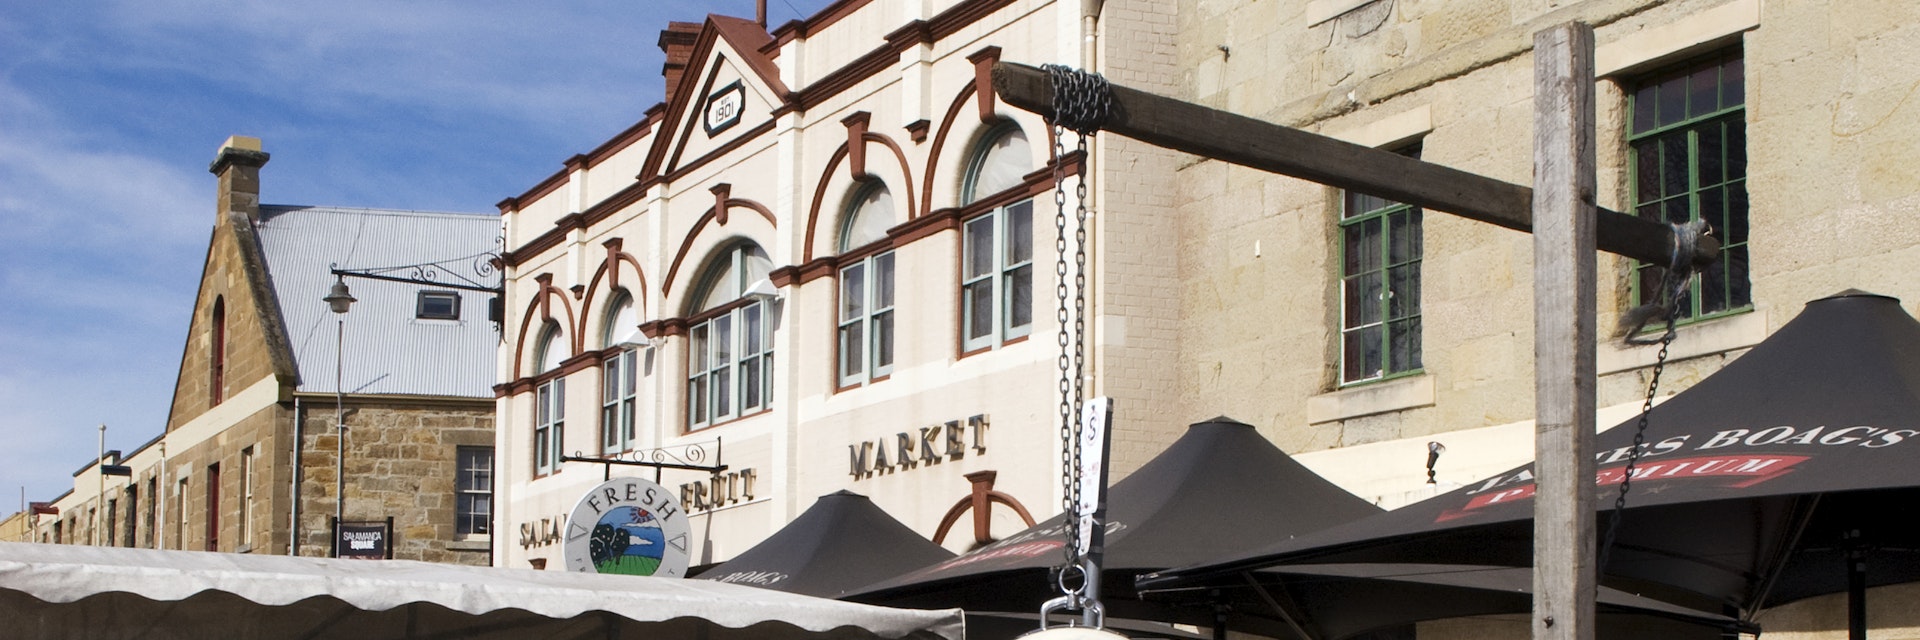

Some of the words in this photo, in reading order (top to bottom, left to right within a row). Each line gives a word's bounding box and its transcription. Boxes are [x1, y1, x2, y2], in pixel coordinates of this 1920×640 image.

[715, 101, 734, 123] 1901
[679, 468, 757, 514] FRUIT
[848, 413, 991, 482] MARKET
[1465, 434, 1692, 496] JAES
[1694, 425, 1920, 451] BOAG'S
[587, 483, 677, 522] FRESH
[343, 531, 382, 541] SALAMANCA
[350, 540, 375, 550] SQUARE
